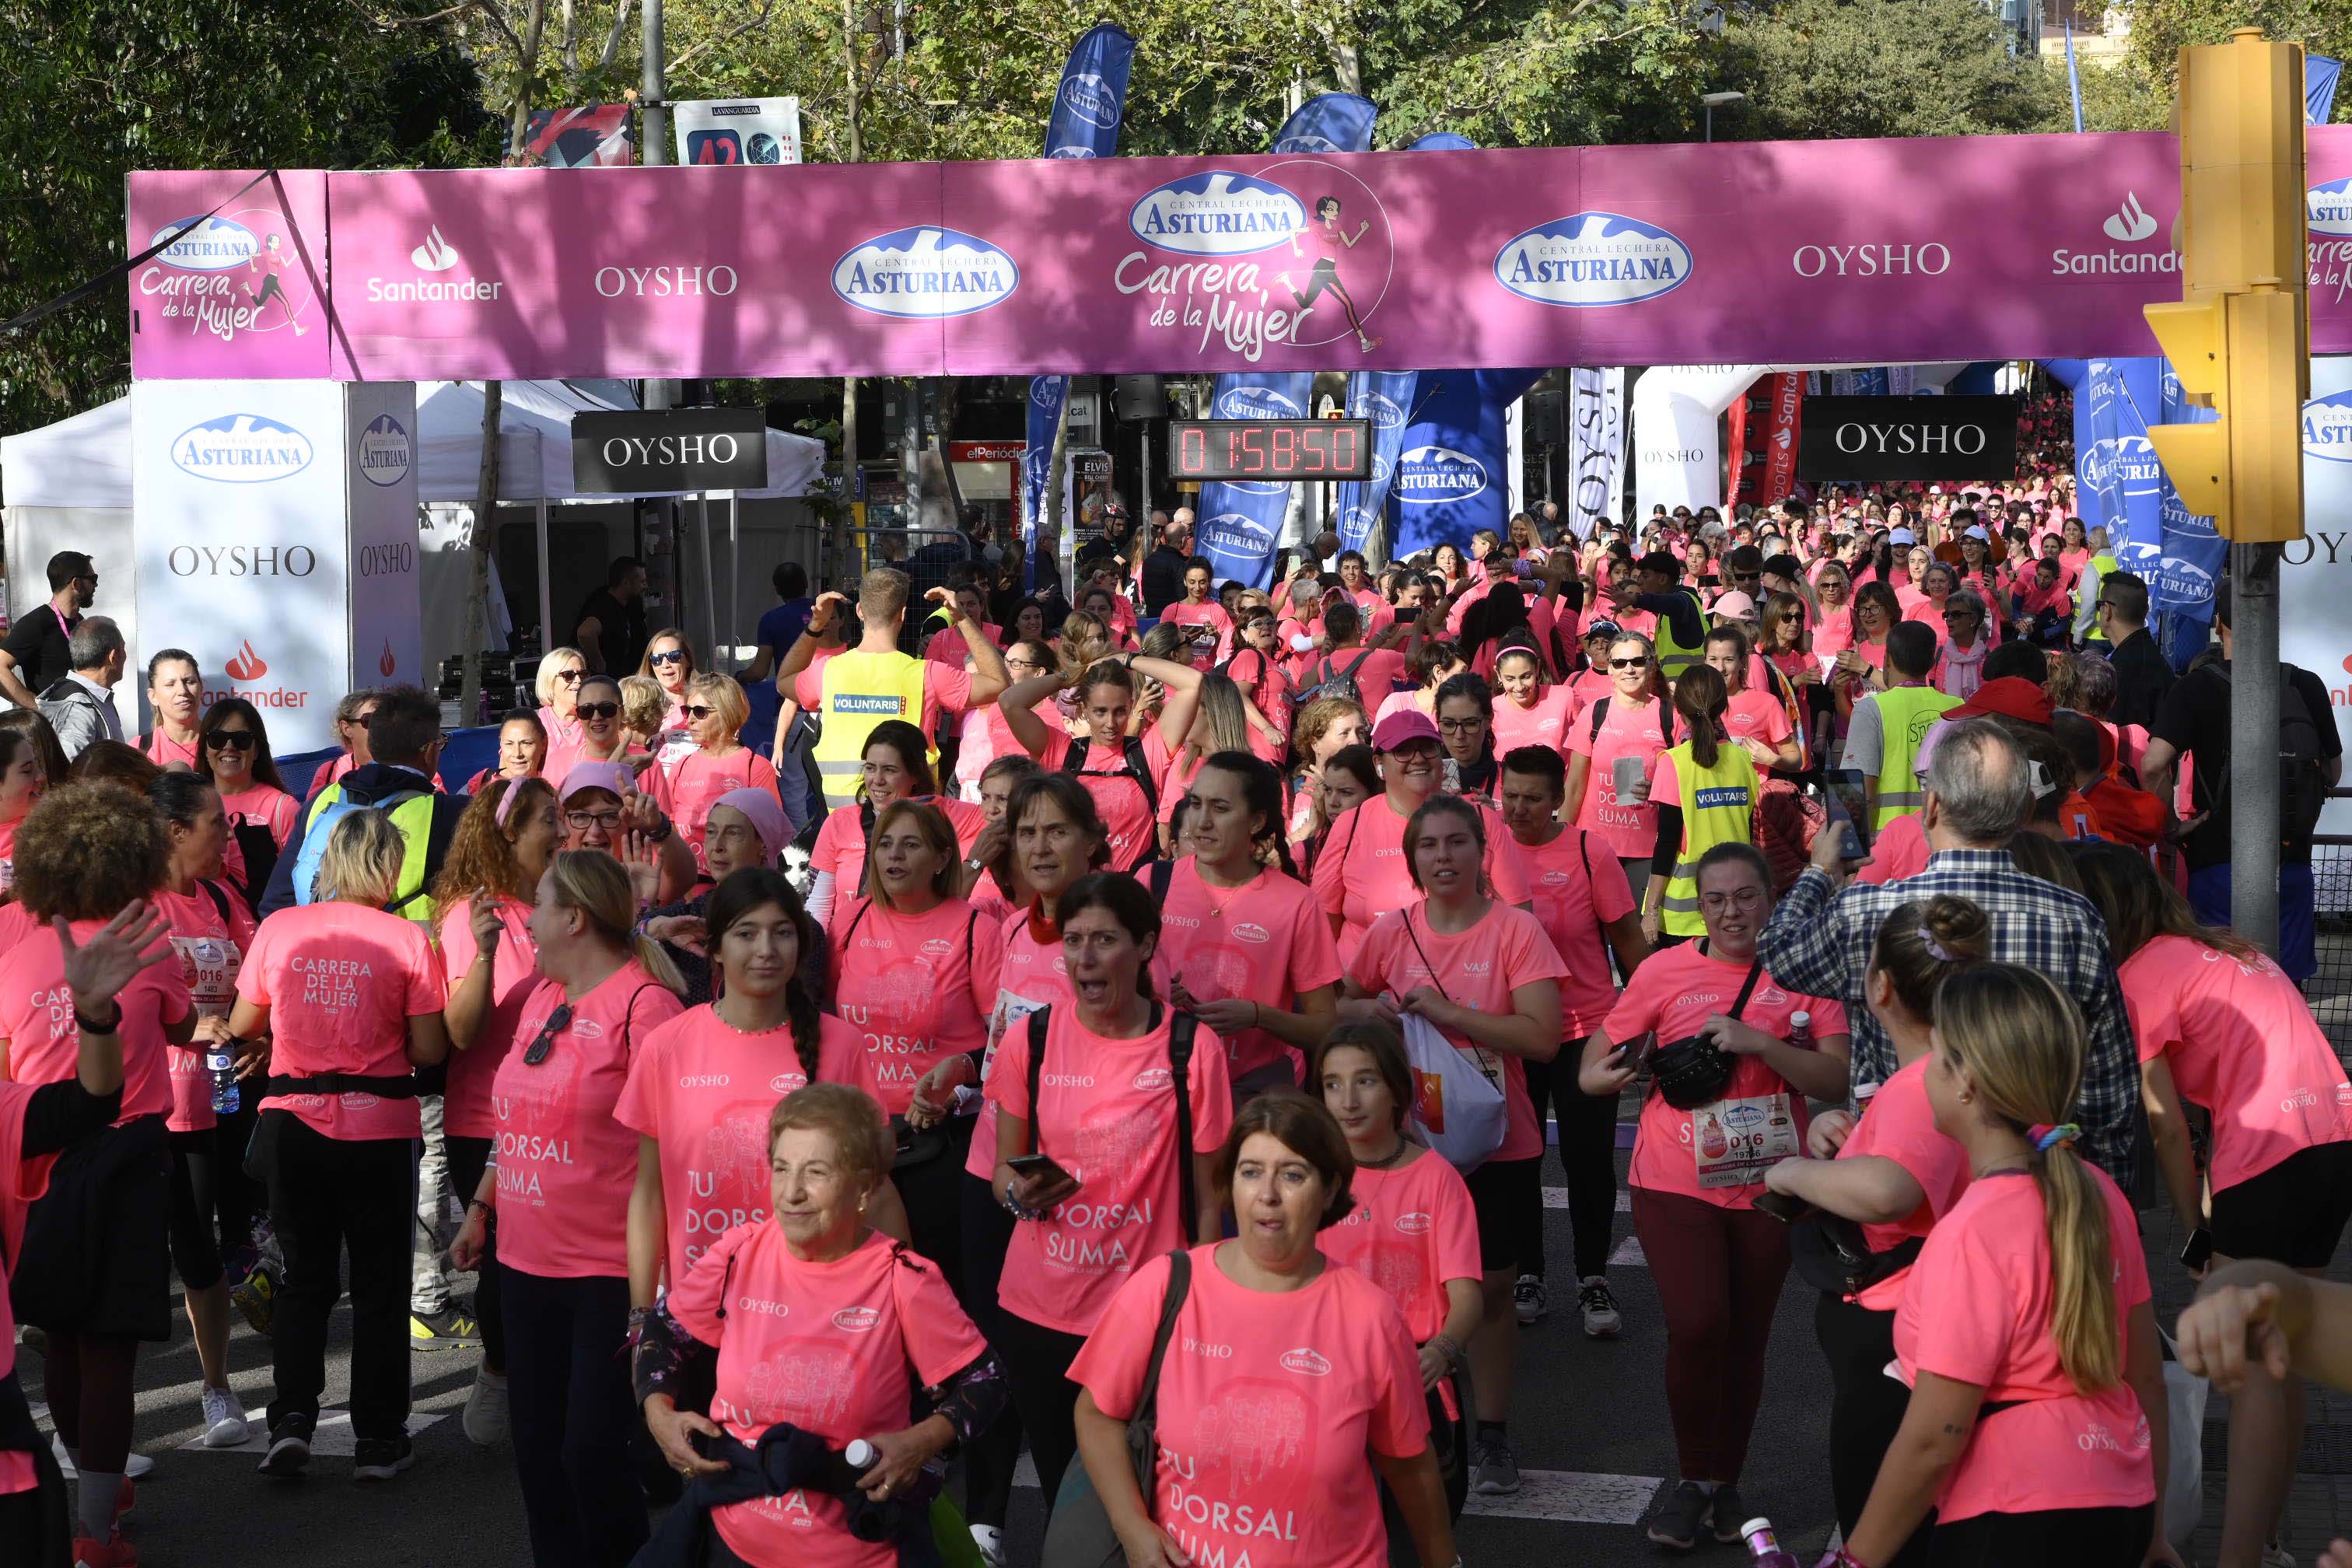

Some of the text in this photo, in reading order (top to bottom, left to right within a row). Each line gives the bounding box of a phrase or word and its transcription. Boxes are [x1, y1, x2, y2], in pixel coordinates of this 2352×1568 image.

[1170, 198, 1288, 209] CENTRAL LECHERA
[1143, 203, 1293, 235] ASTURIANA
[158, 236, 250, 256] ASTURIANA
[1539, 243, 1671, 256] CENTRAL LECHERA
[875, 256, 998, 267] CENTRAL LECHERA
[1509, 249, 1676, 283] ASTURIANA
[1793, 243, 1951, 277] OYSHO
[140, 266, 231, 296] Carrera
[595, 266, 738, 297] OYSHO
[845, 261, 1003, 294] ASTURIANA
[1115, 251, 1260, 295] Carrera
[367, 277, 502, 302] Santander
[162, 292, 265, 341] de la Mujer
[1150, 290, 1315, 362] de la Mujer
[1836, 422, 1986, 454] OYSHO
[183, 439, 303, 465] ASTURIANA
[362, 441, 408, 468] ASTURIANA
[604, 433, 738, 467] OYSHO
[1181, 428, 1356, 472] 01:58:50
[1645, 448, 1704, 464] OYSHO
[1084, 462, 1108, 472] ELVIS
[1391, 471, 1481, 490] ASTURIANA
[1203, 525, 1269, 553] ASTURIANA
[169, 546, 316, 576] OYSHO
[360, 542, 411, 577] OYSHO
[200, 687, 308, 708] antander
[835, 698, 898, 710] VOLUNTARIS
[1598, 808, 1640, 825] SUMA
[1161, 914, 1200, 929] OYSHO
[859, 938, 892, 950] OYSHO
[200, 969, 223, 982] 016
[291, 957, 373, 978] CARRERA
[204, 985, 218, 993] 1483
[306, 973, 356, 991] DE LA
[303, 989, 359, 1007] MUJER
[1678, 993, 1720, 1006] OYSHO
[841, 1003, 867, 1025] TU
[863, 1033, 940, 1055] ORSAL
[680, 1074, 730, 1088] OYSHO
[1045, 1073, 1094, 1089] OYSHO
[1726, 1114, 1762, 1125] ASTURIANA
[1730, 1132, 1764, 1149] 016
[496, 1165, 543, 1197] SUMA
[688, 1169, 714, 1198] TU
[1706, 1173, 1738, 1183] OYSHO
[1046, 1231, 1129, 1265] SUMA
[739, 1296, 789, 1318] OYSHO
[1163, 1447, 1195, 1480] TU
[1170, 1482, 1299, 1542] DORSAL
